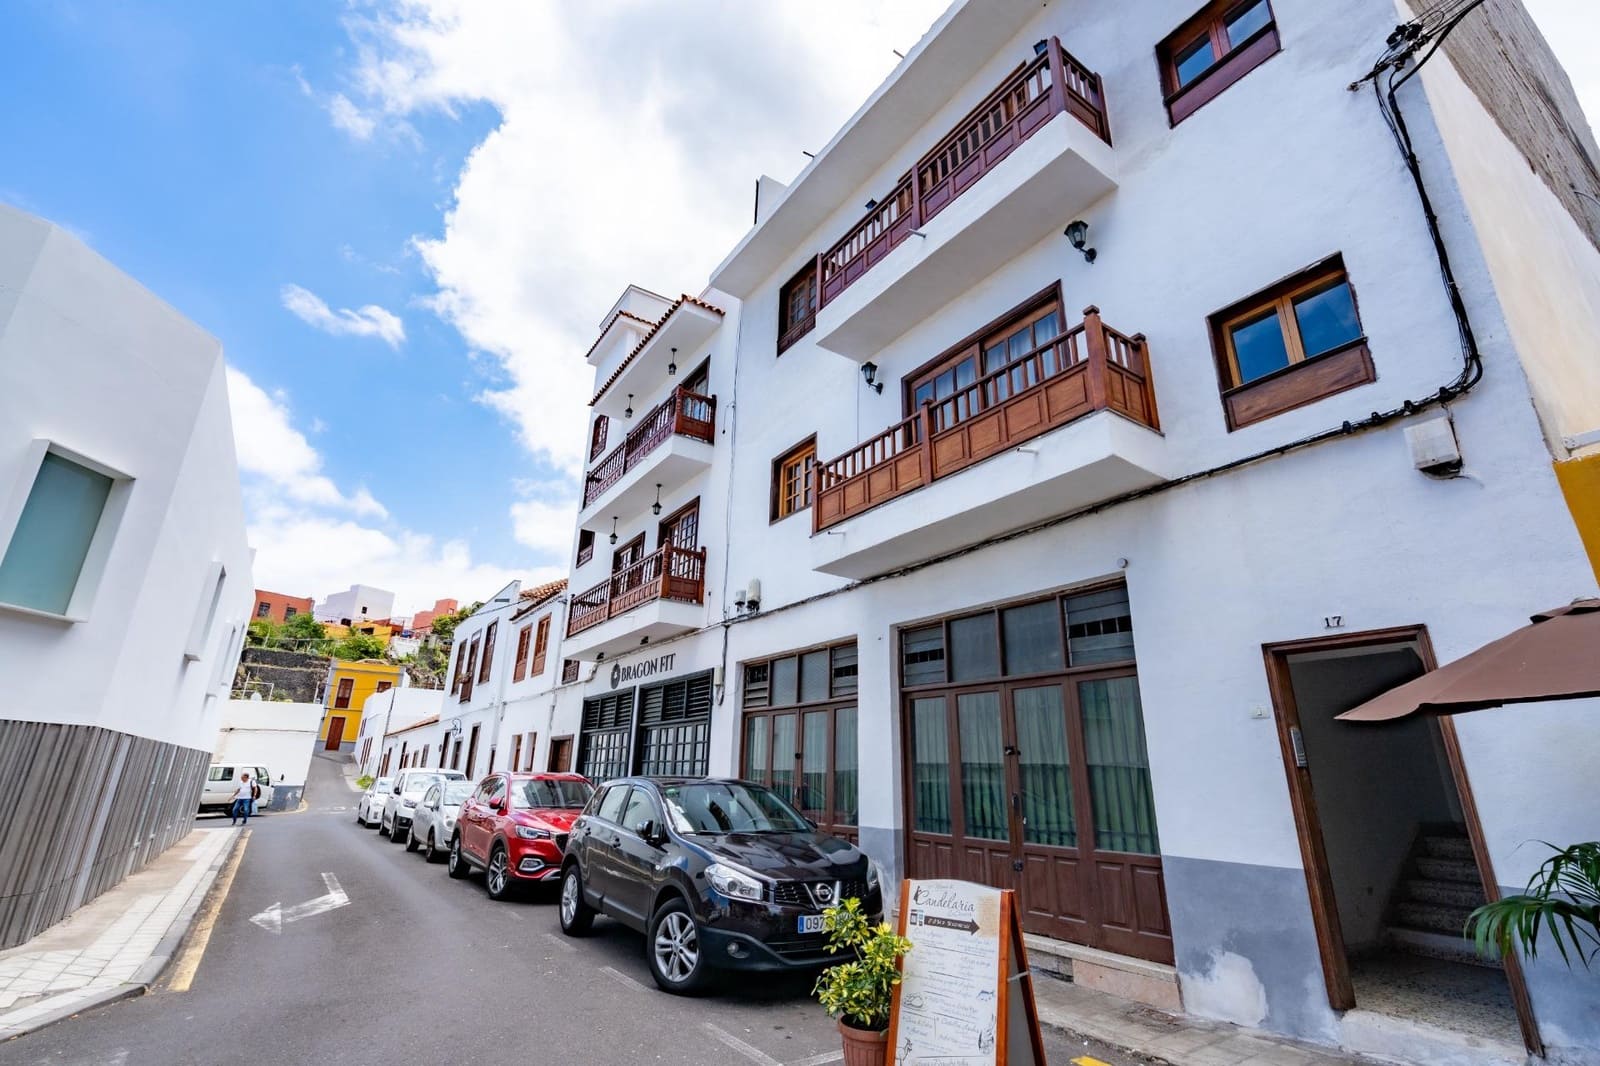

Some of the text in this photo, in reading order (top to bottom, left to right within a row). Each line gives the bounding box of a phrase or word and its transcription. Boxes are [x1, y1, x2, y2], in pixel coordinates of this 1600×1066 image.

[1324, 615, 1342, 628] 17
[621, 652, 676, 682] BRAGON FIT
[915, 889, 976, 913] Candelaria
[805, 916, 825, 930] 097
